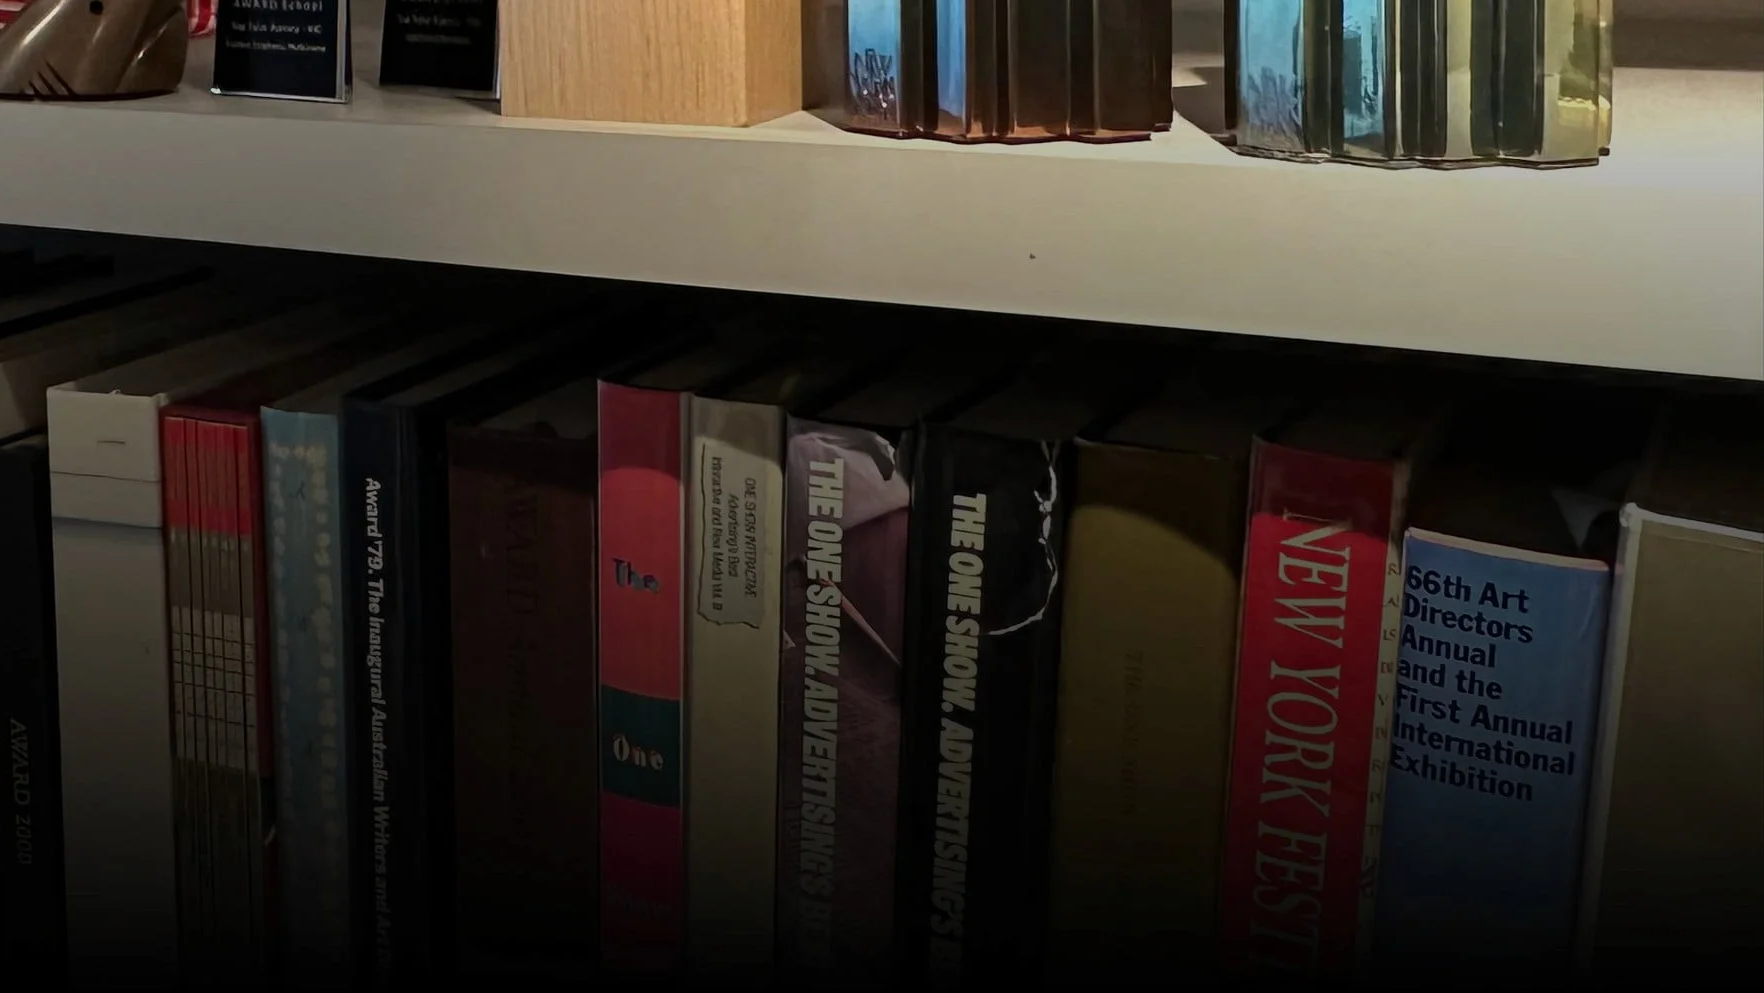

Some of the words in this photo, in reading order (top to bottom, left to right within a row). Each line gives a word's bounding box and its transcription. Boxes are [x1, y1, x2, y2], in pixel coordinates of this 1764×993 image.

[281, 0, 323, 13] School
[364, 477, 383, 538] Award
[744, 477, 757, 499] ONE
[744, 501, 757, 533] SHOW
[808, 458, 846, 519] THE
[950, 492, 987, 552] THE
[367, 539, 385, 575] '79.
[611, 557, 661, 595] The
[744, 535, 757, 599] INTERACTIVE
[804, 520, 844, 586] ONE
[946, 552, 983, 615] ONE
[1272, 508, 1354, 649] NEW
[367, 577, 384, 616] The
[1402, 593, 1533, 644] Directors
[1406, 564, 1472, 603] 66th
[1477, 582, 1531, 614] Art
[804, 584, 844, 676] SHOW.
[1400, 624, 1497, 668] Annual
[940, 615, 979, 713] SHOW.
[1398, 658, 1446, 688] and
[1454, 669, 1503, 700] the
[1257, 660, 1342, 818] YORK
[1393, 712, 1577, 777] International
[1396, 683, 1462, 723] First
[1470, 704, 1574, 745] Annual
[9, 719, 30, 806] AWARD
[370, 707, 390, 803] Australian
[612, 734, 666, 772] One
[1389, 741, 1533, 802] Exhibition
[800, 679, 840, 896] ADVERTISING'S
[15, 814, 33, 865] 2000
[373, 805, 392, 875] Writers
[930, 718, 975, 937] ADVERTISING'S
[375, 876, 393, 913] and
[375, 914, 394, 946] Art
